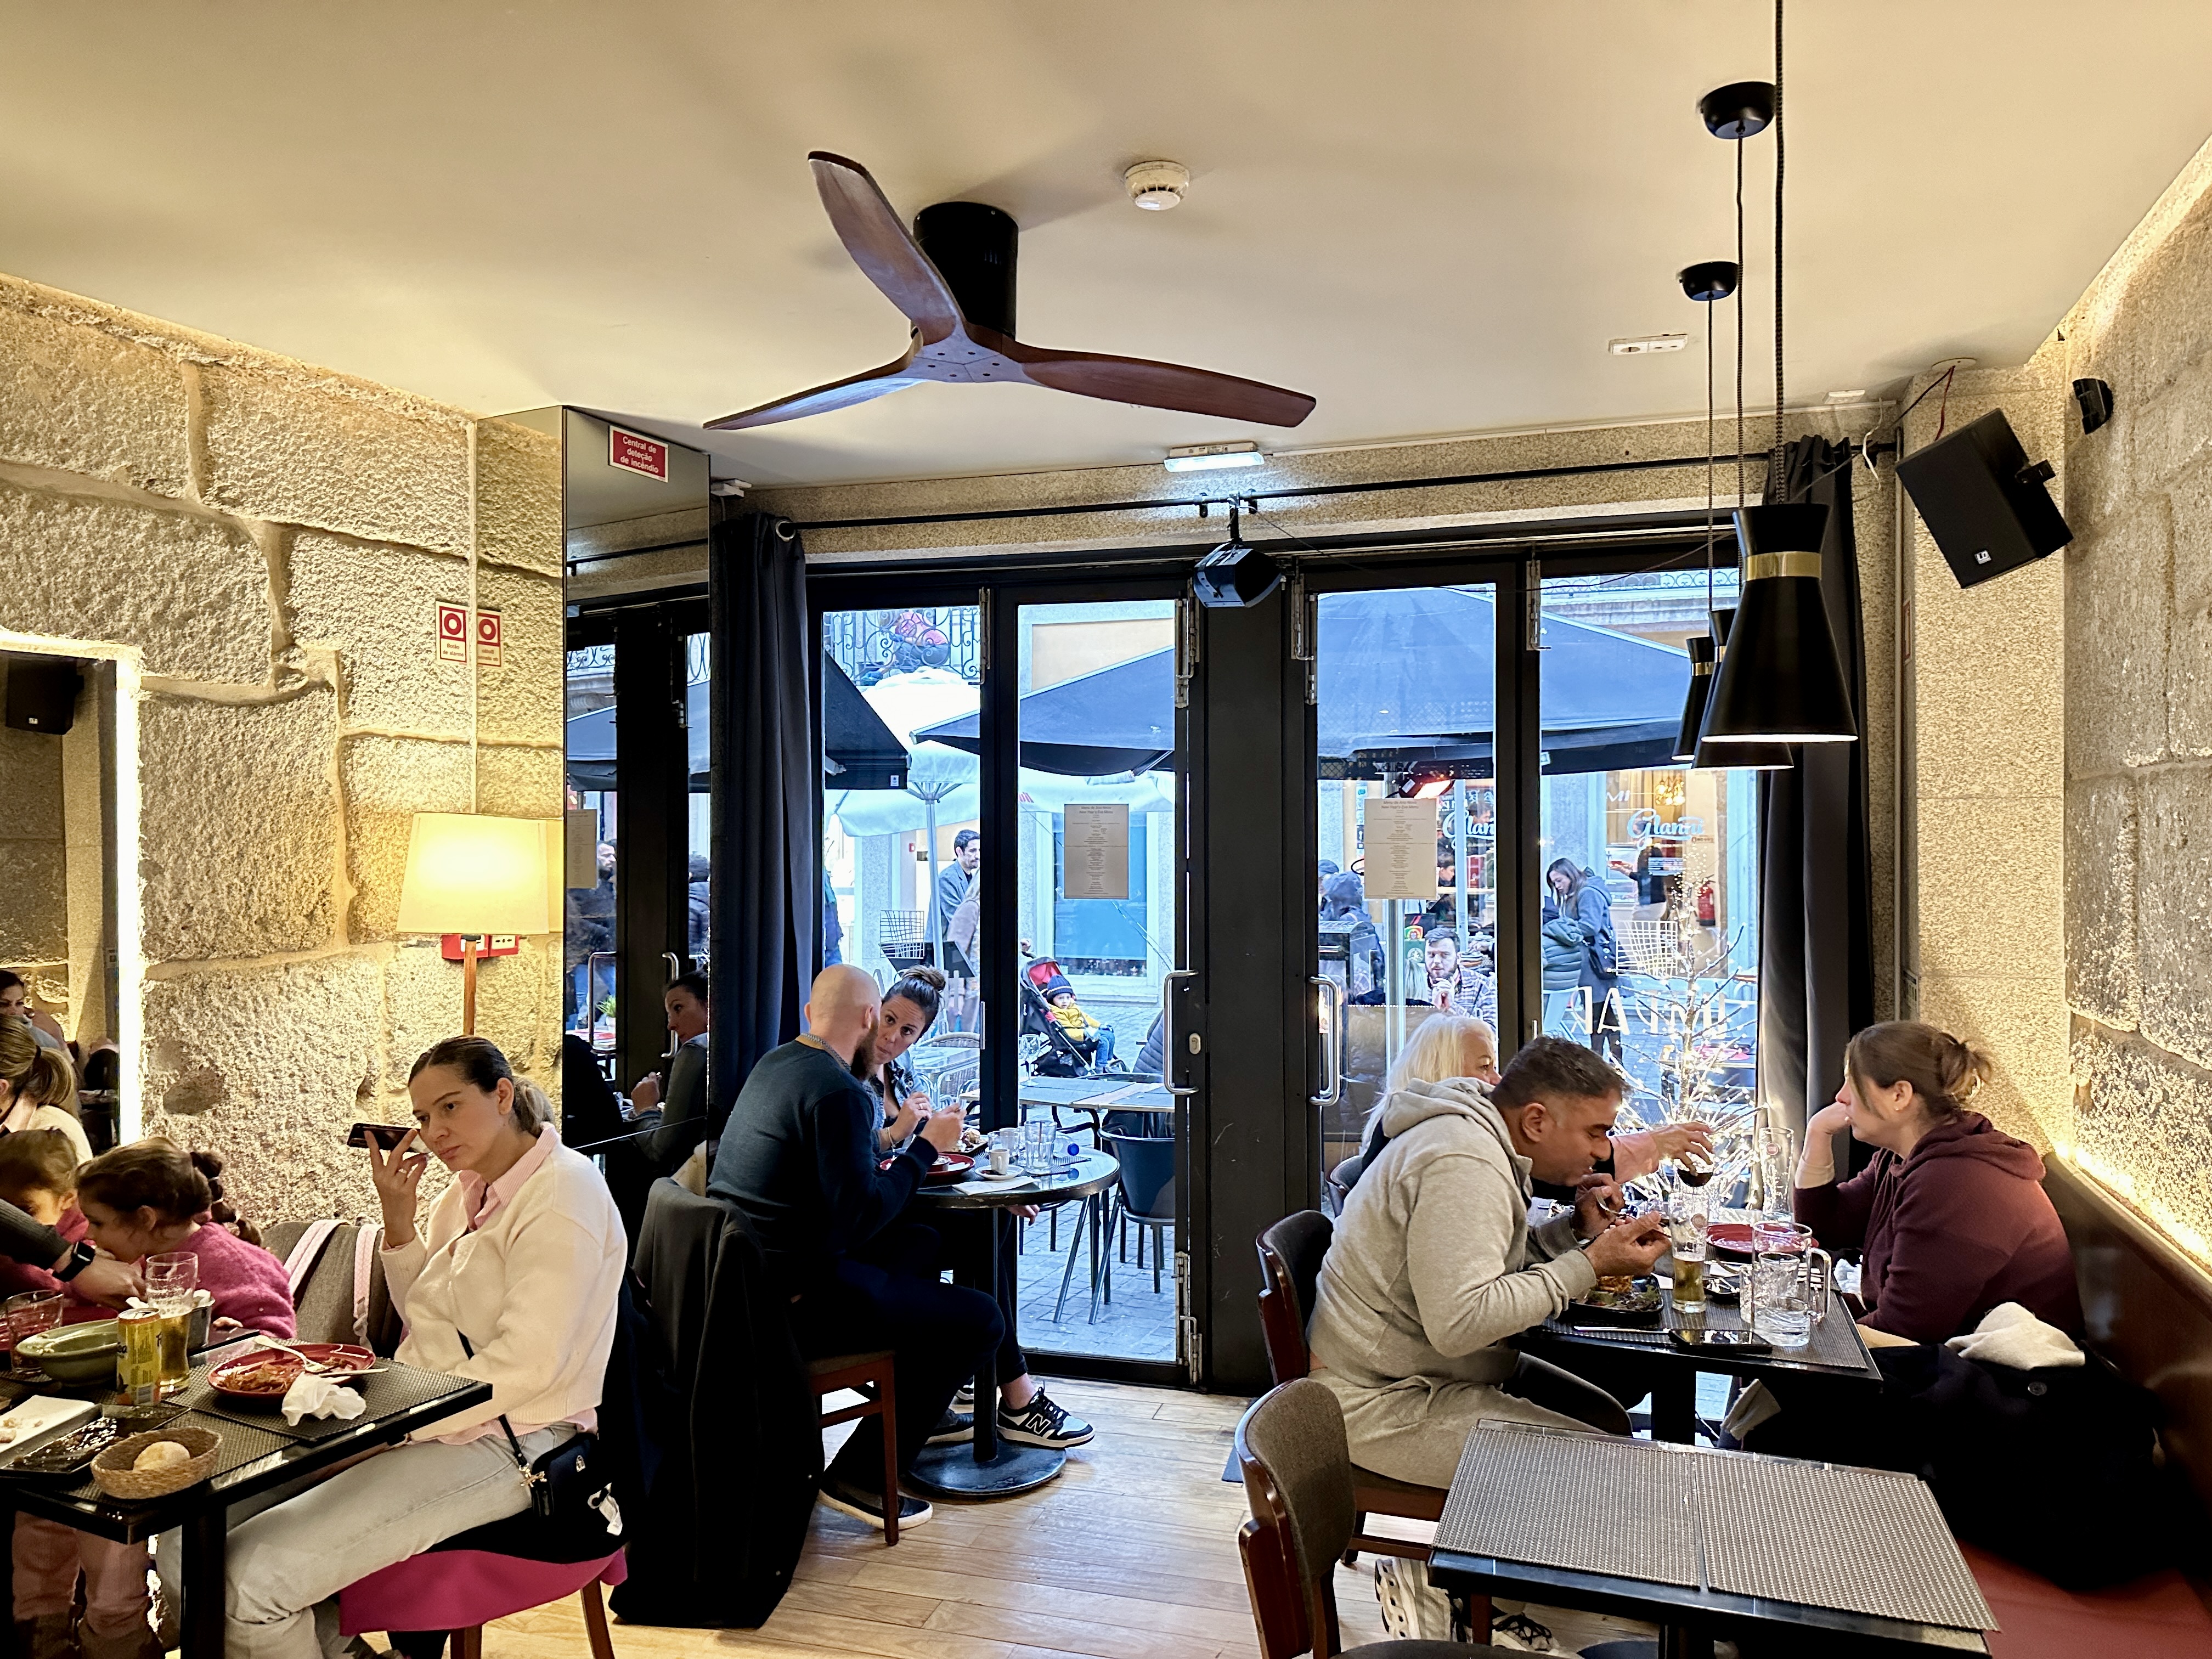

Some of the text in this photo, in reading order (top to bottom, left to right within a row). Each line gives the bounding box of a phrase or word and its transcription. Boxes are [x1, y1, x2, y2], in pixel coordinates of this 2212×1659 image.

[623, 436, 657, 453] Central de
[627, 448, 653, 461] deteção
[631, 458, 659, 473] incêndio
[1025, 1413, 1052, 1435] N
